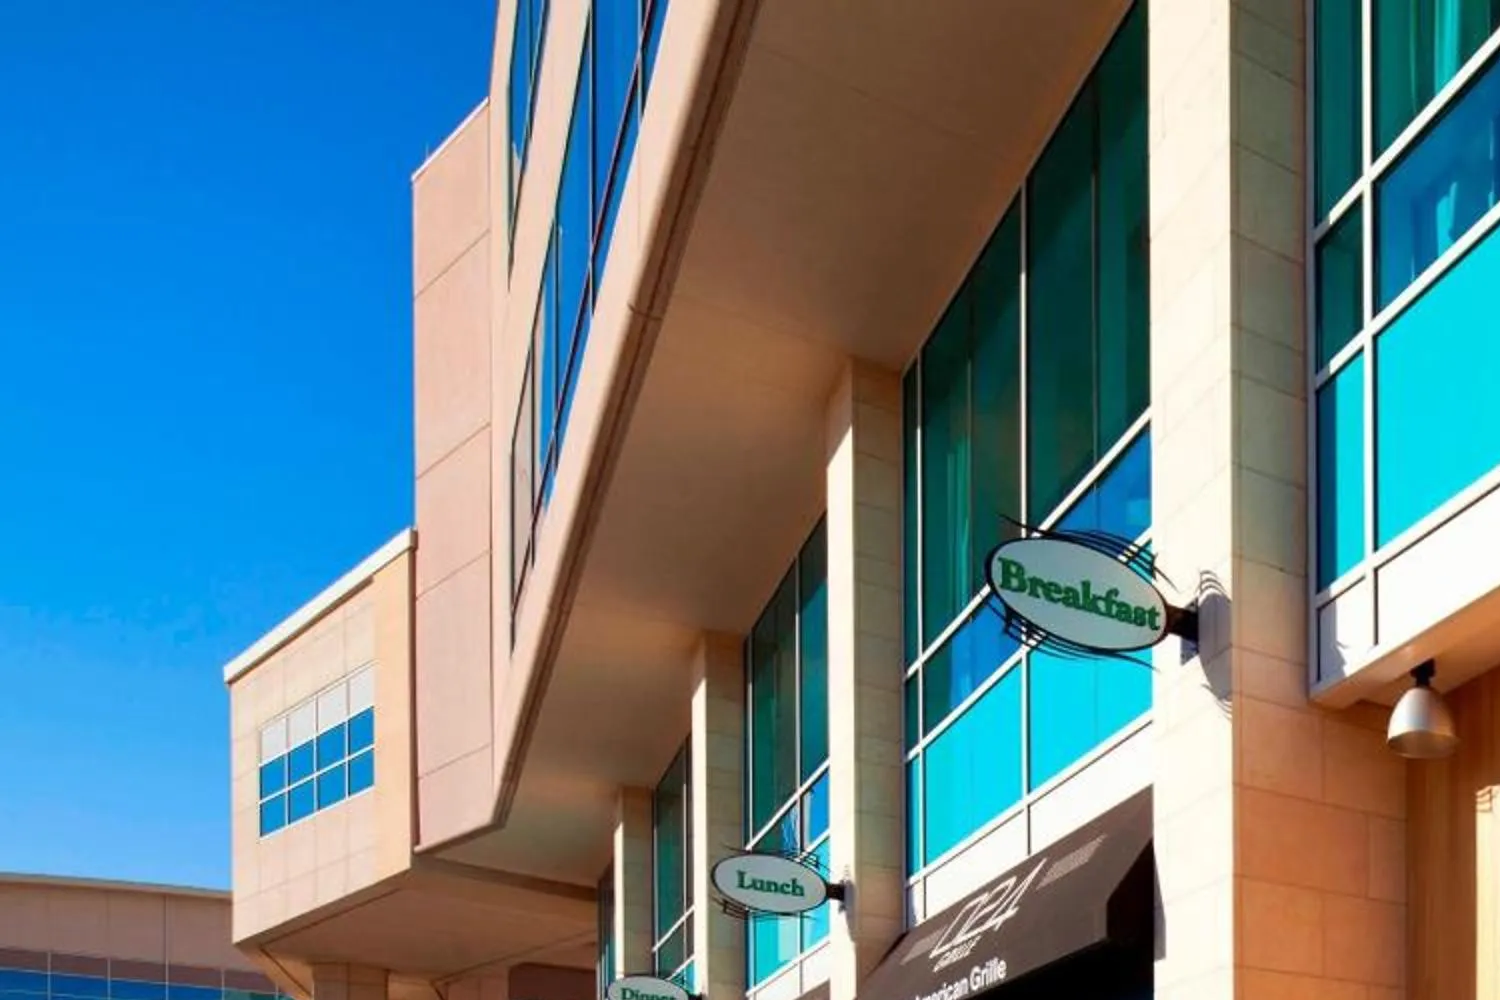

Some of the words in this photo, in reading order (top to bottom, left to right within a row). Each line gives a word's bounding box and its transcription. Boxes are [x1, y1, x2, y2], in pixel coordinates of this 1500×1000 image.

[997, 557, 1160, 630] Breakfast
[736, 870, 805, 896] Lunch
[969, 956, 1007, 991] Grille
